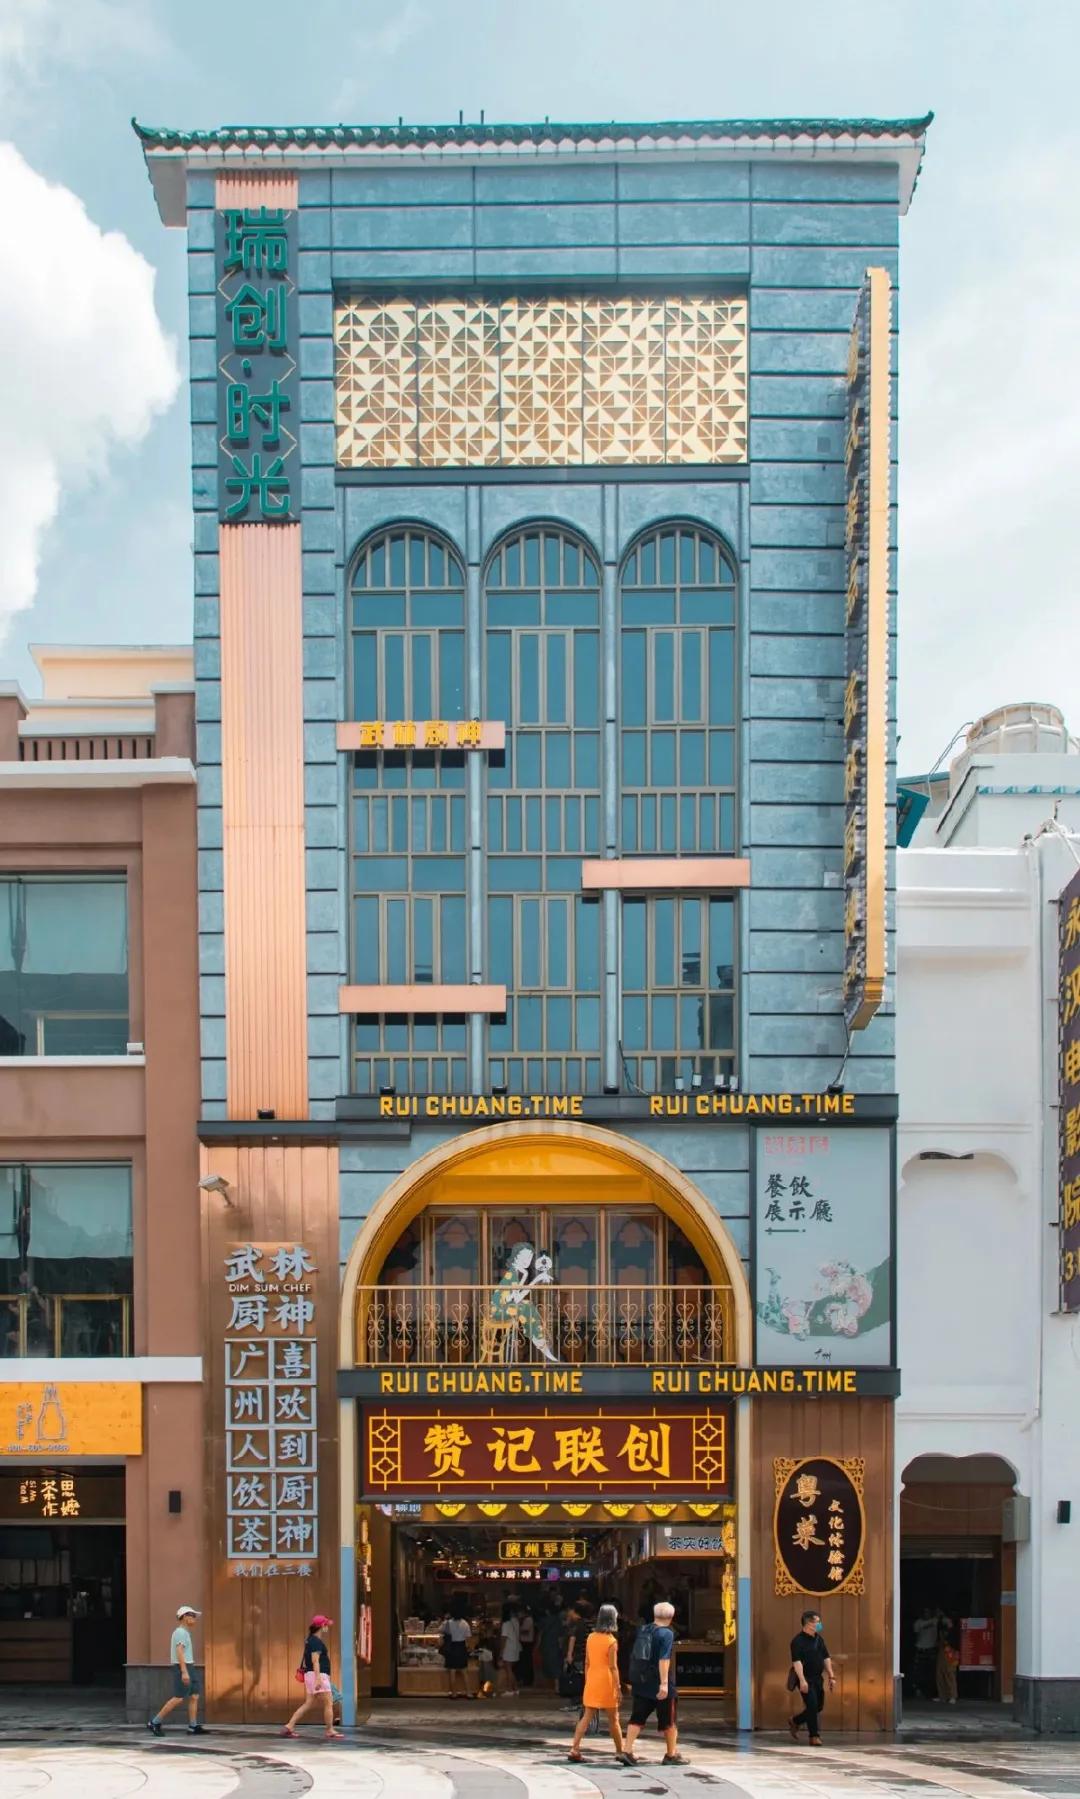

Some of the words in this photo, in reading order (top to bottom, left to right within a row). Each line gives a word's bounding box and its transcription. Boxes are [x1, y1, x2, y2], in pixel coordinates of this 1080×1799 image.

[224, 206, 290, 516] 瑞创·时光
[380, 1096, 417, 1115] RUI
[426, 1096, 583, 1115] CHUANG.TIME
[651, 1095, 688, 1114] RUI
[696, 1094, 855, 1114] CHUANG.TIME
[765, 1174, 813, 1198] 餐飲
[224, 1244, 320, 1283] 武林
[229, 1283, 249, 1292] DIM
[254, 1283, 279, 1292] SUM
[283, 1283, 312, 1292] CHEF
[226, 1295, 314, 1335] 厨神
[381, 1372, 418, 1393] RUI
[426, 1372, 583, 1393] CHUANG.TIME
[653, 1371, 690, 1392] RUI
[699, 1371, 857, 1392] CHUANG.TIME
[233, 1343, 268, 1551] 广州人饮茶
[276, 1342, 313, 1550] 喜欢到厨神
[422, 1422, 670, 1478] 赞记联创
